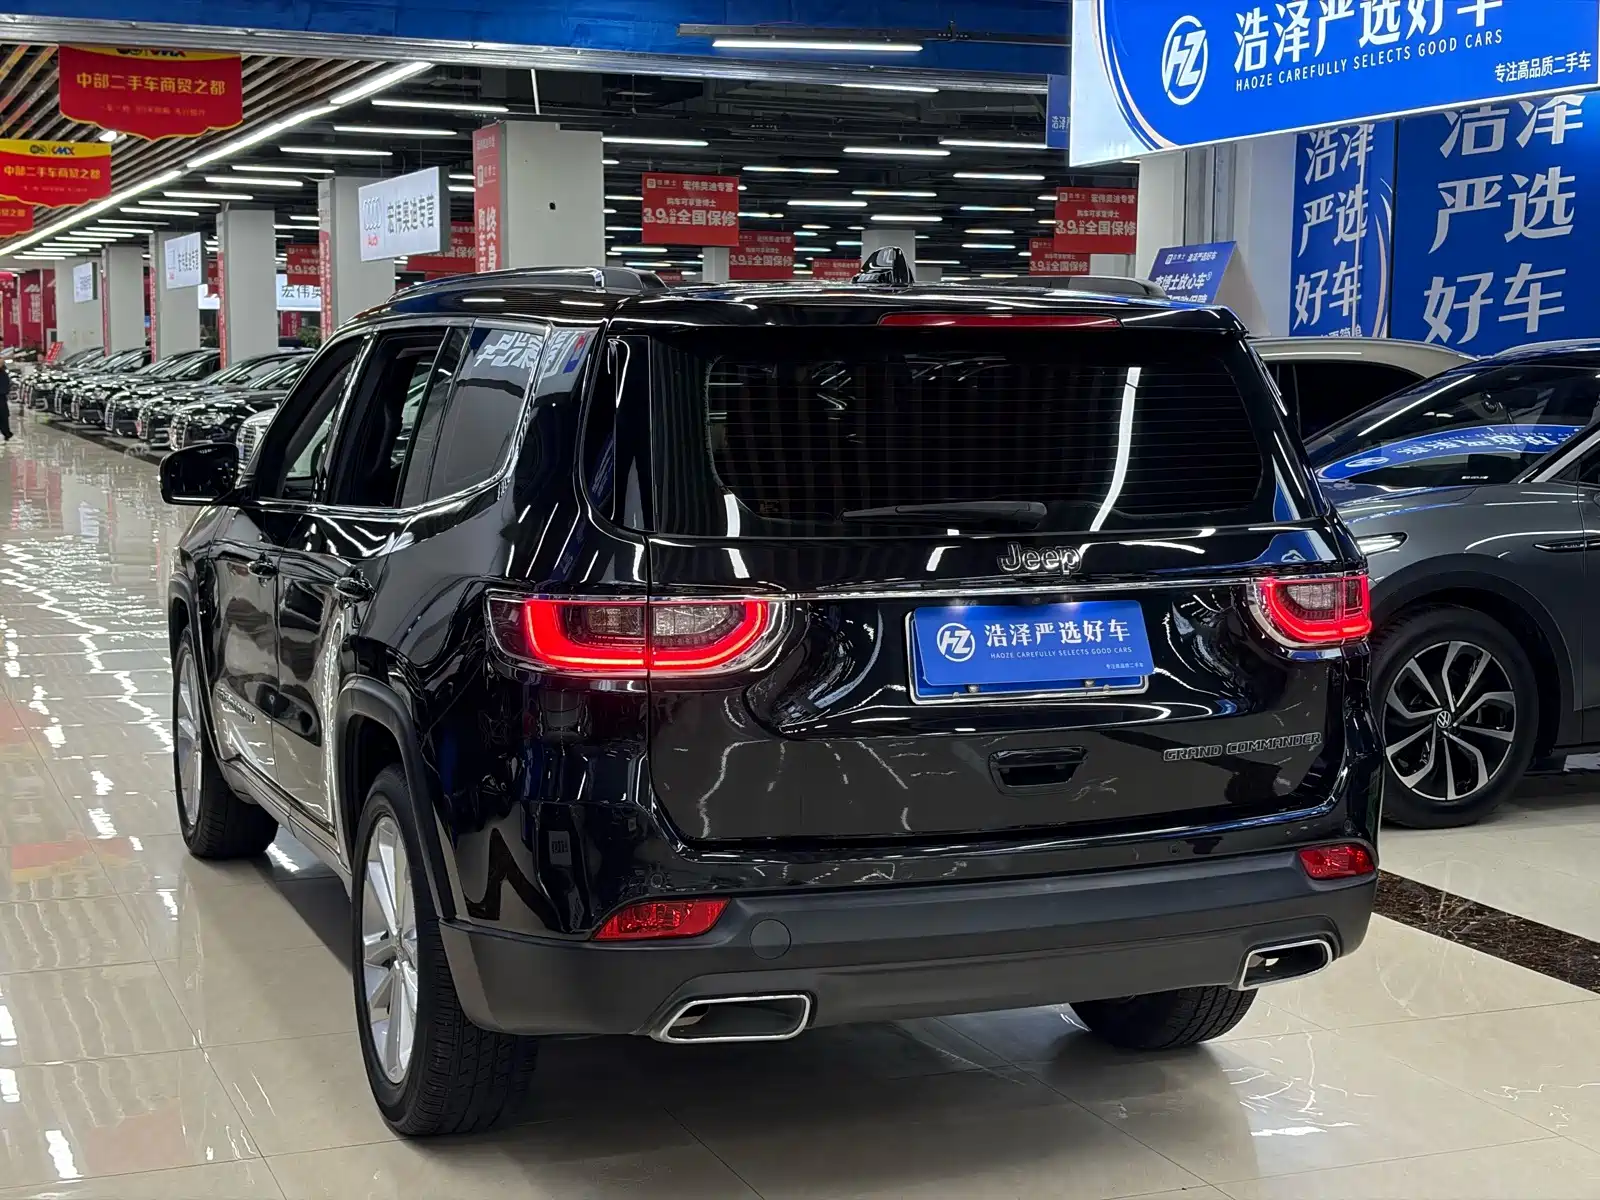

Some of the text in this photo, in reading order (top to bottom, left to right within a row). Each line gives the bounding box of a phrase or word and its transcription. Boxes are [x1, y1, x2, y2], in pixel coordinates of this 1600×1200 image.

[1235, 29, 1503, 92] HAOZE CAREFULLY SELECTS GOOD CARS
[1494, 50, 1592, 83] 专注高品质二手车
[76, 71, 226, 96] 中部二手车商贸之都
[1297, 184, 1369, 258] 严选
[1427, 165, 1576, 254] 严选
[1292, 261, 1363, 331] 好车
[1423, 263, 1567, 344] 好车
[997, 542, 1081, 577] Jeep
[983, 618, 1131, 648] 浩泽严选好车
[1016, 649, 1056, 658] CAREFULLY
[1058, 648, 1089, 657] SELECTS
[1091, 647, 1112, 655] GOOD
[1113, 646, 1133, 654] CARS
[1163, 732, 1322, 762] GRAND COMMANDER
